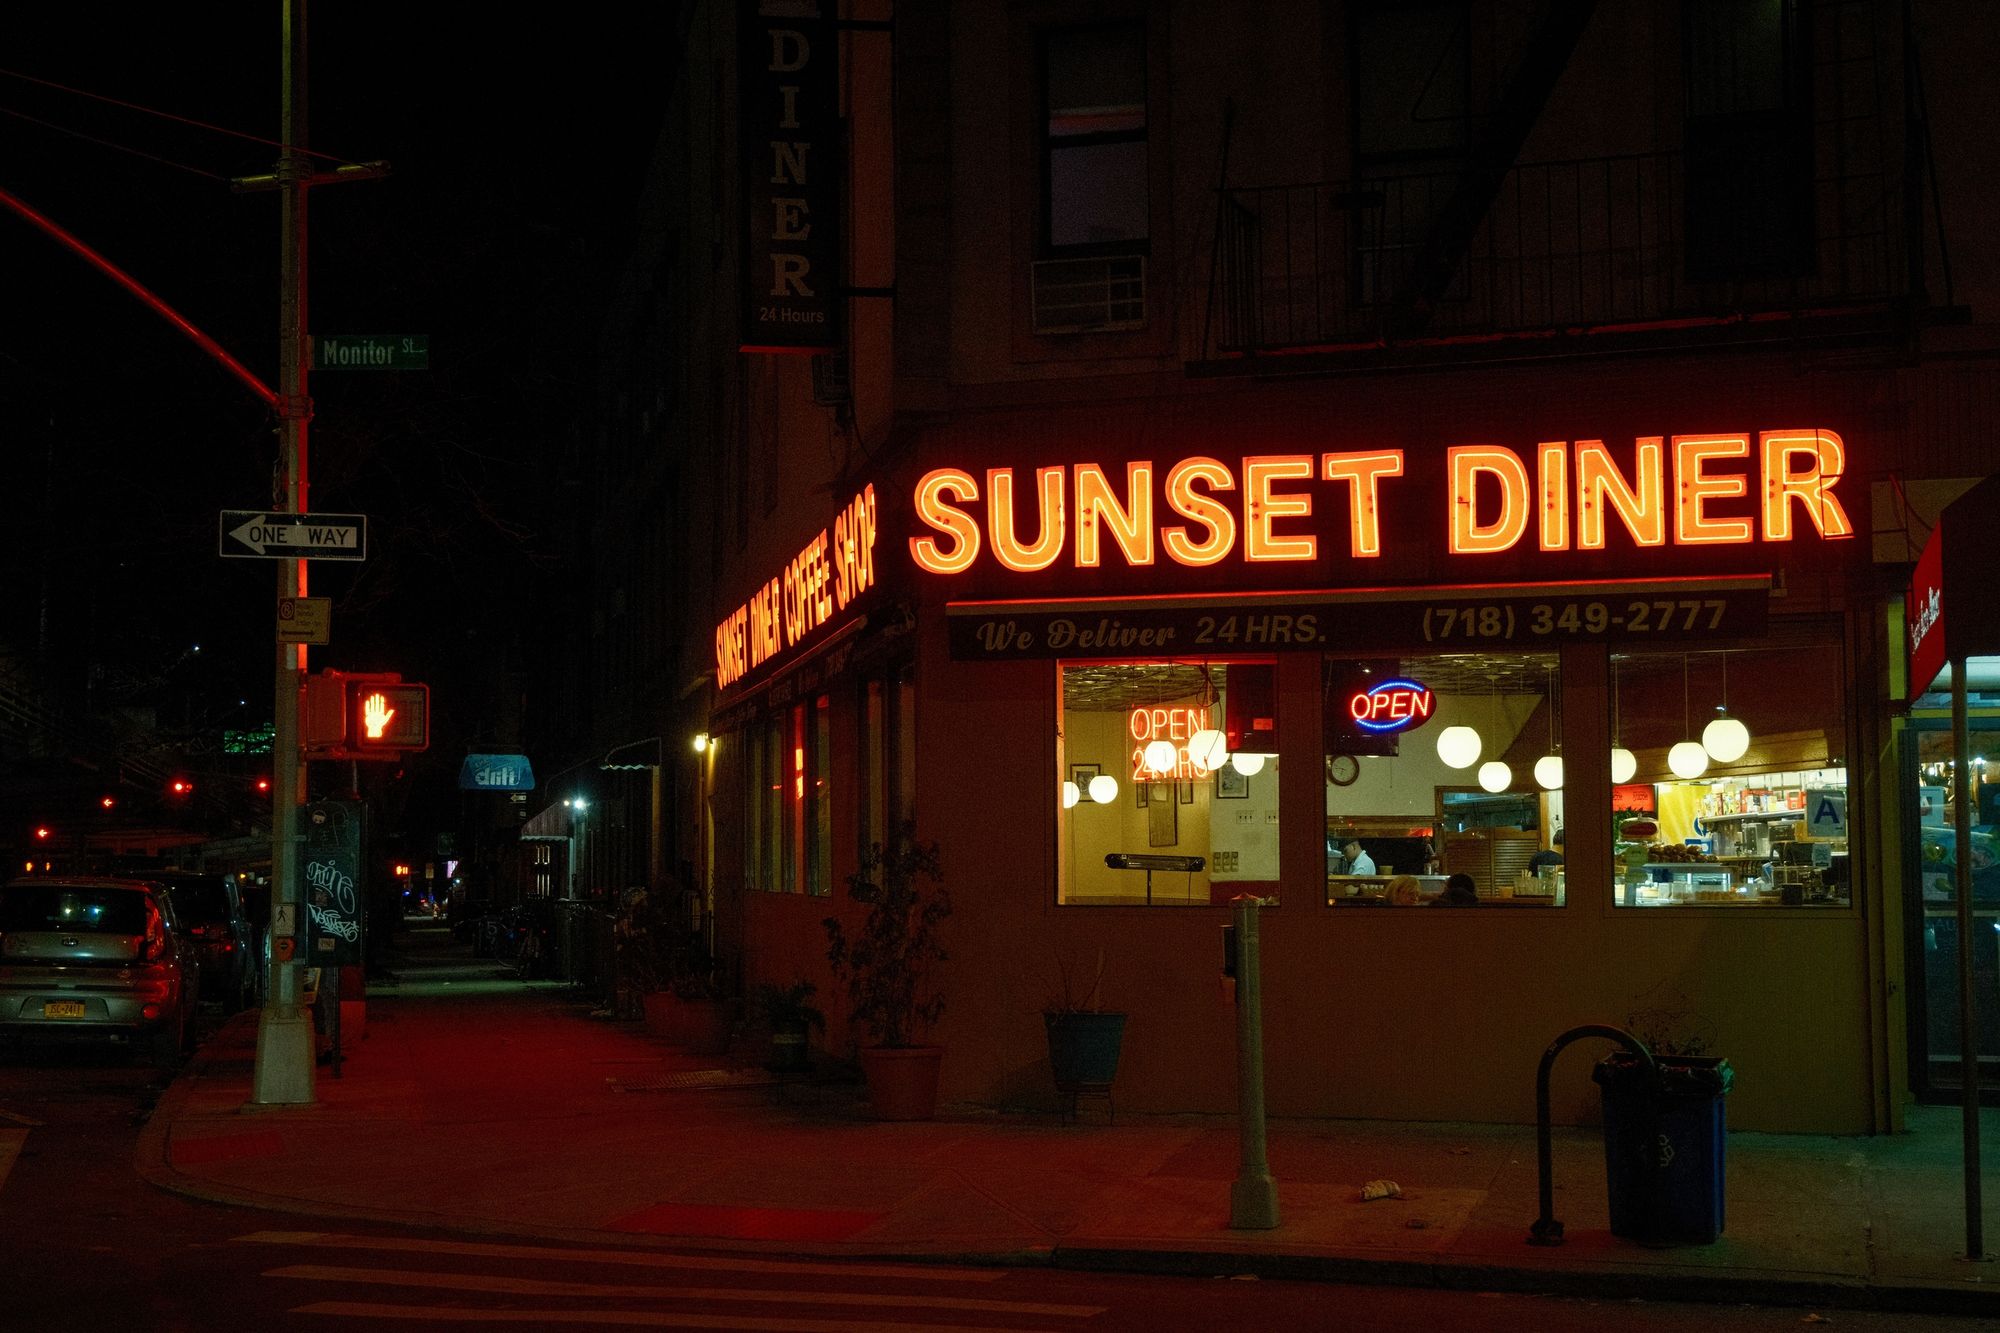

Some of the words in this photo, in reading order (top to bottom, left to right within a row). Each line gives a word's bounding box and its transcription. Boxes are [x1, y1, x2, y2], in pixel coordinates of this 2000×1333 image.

[767, 29, 816, 297] DINER
[759, 307, 777, 321] 24
[781, 307, 824, 323] Hours
[323, 339, 395, 365] Monitor
[908, 448, 1404, 574] SUNSET
[1447, 429, 1856, 555] DINER
[249, 526, 288, 544] ONE
[308, 528, 349, 545] WAY
[716, 603, 748, 690] SUNSET
[750, 577, 782, 669] DINER
[784, 528, 833, 648] COFFEE
[834, 482, 877, 612] SHOP
[975, 619, 1035, 652] We
[1047, 618, 1176, 650] Deliver
[1193, 616, 1239, 644] 24
[1422, 604, 1516, 642] (718)
[1530, 598, 1728, 635] 349-2777
[1351, 690, 1431, 720] OPEN
[1130, 708, 1205, 741] OPEN
[1814, 796, 1841, 825] A
